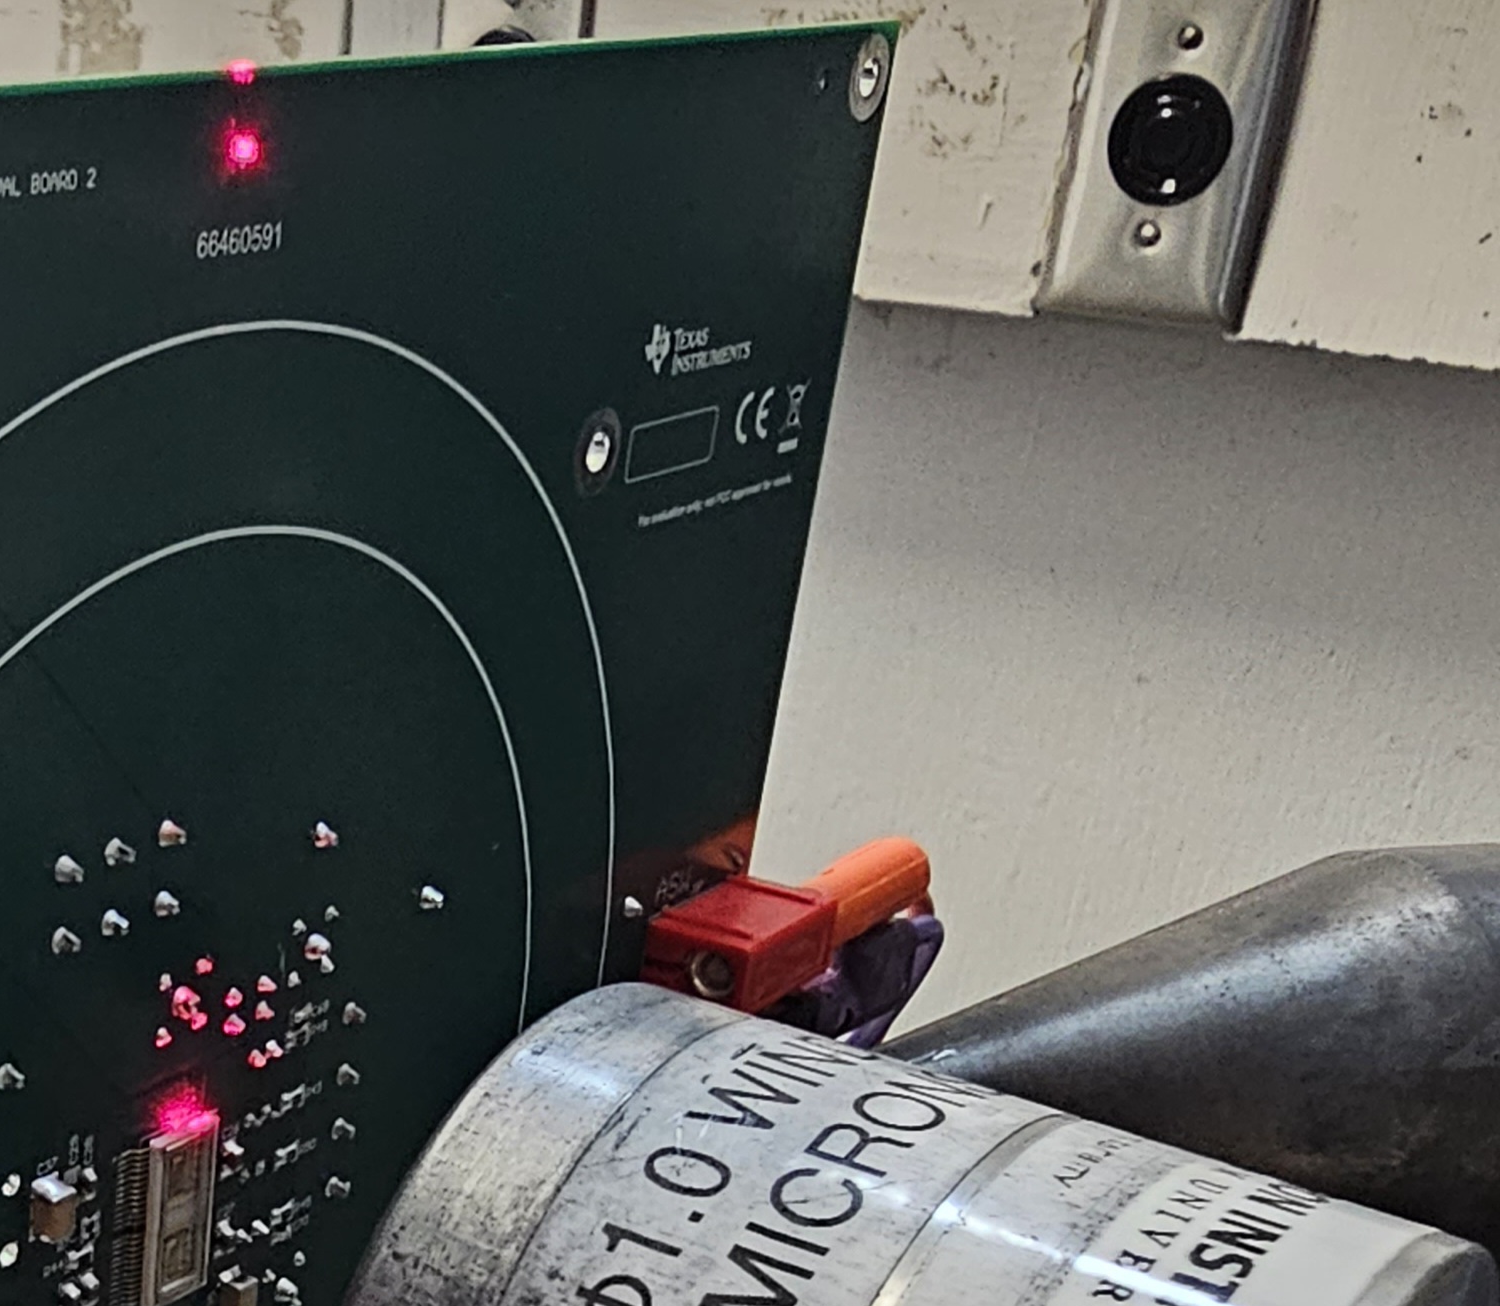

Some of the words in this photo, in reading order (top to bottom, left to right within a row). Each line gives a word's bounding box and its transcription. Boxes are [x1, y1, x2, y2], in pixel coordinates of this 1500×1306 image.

[30, 168, 78, 196] BOARD
[86, 166, 97, 190] 2
[196, 220, 282, 259] 66460591
